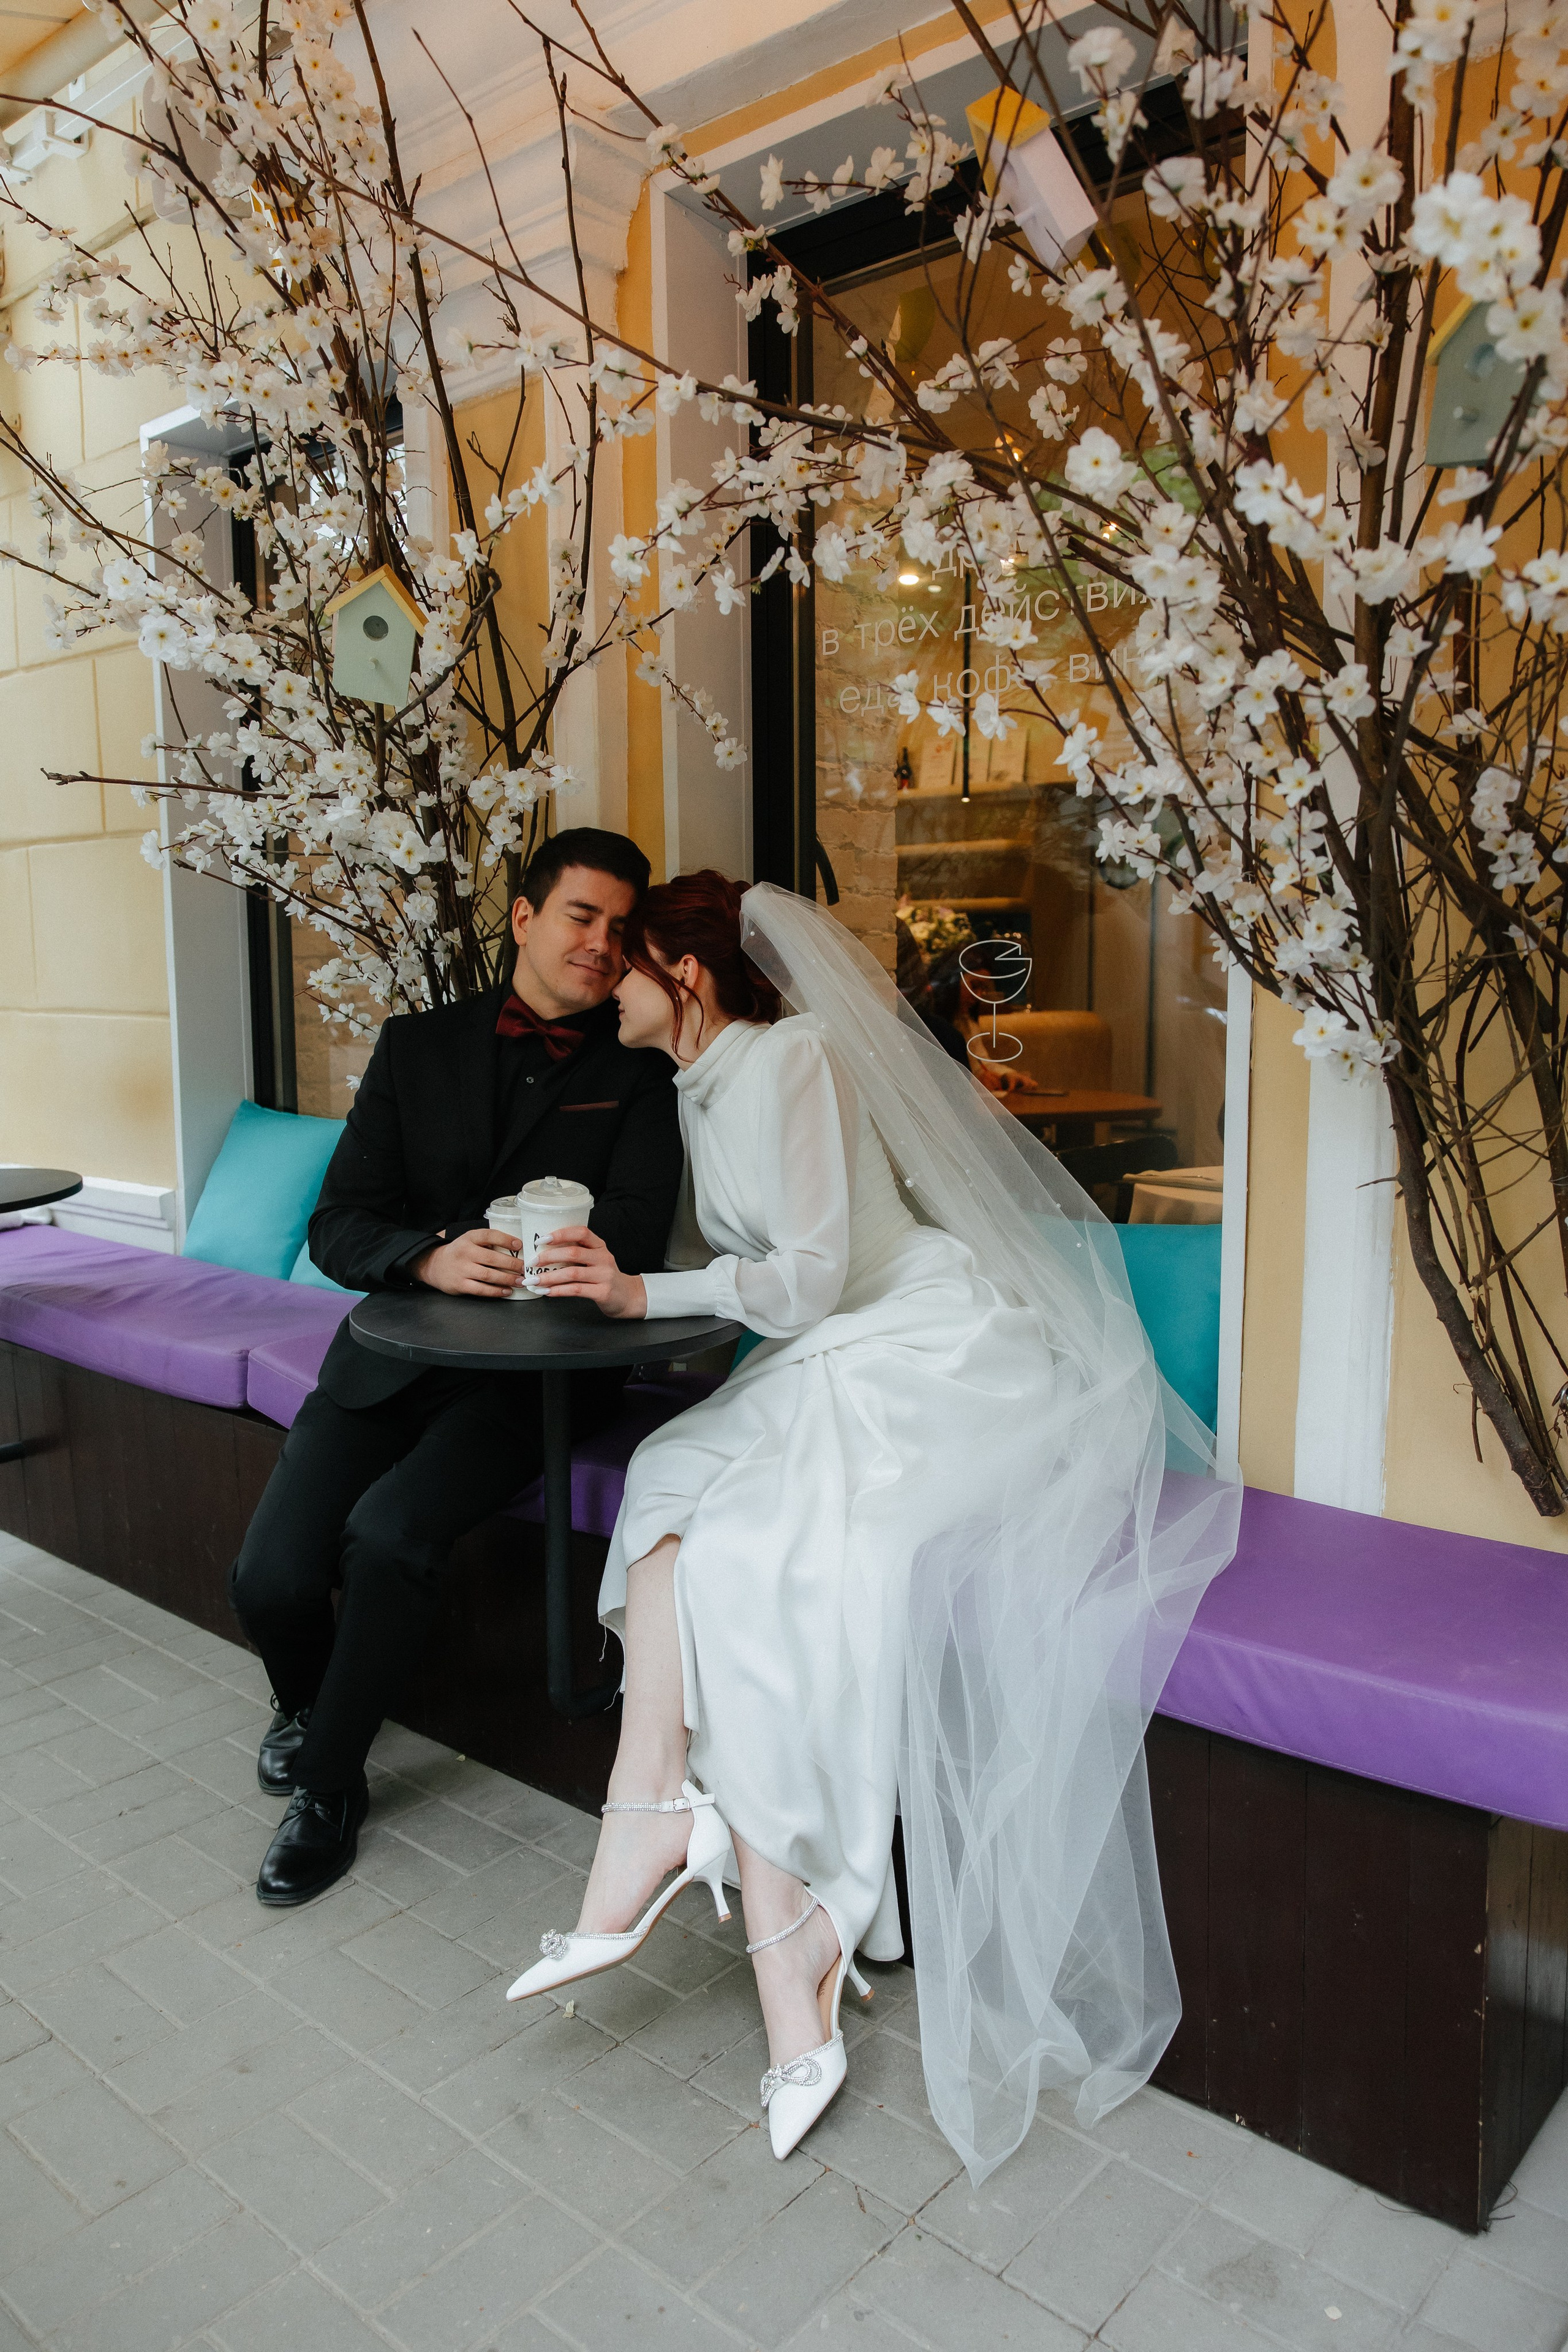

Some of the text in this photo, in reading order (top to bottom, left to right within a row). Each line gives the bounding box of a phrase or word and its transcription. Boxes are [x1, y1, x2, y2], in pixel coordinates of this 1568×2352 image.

[822, 579, 1147, 657] в трёх действи
